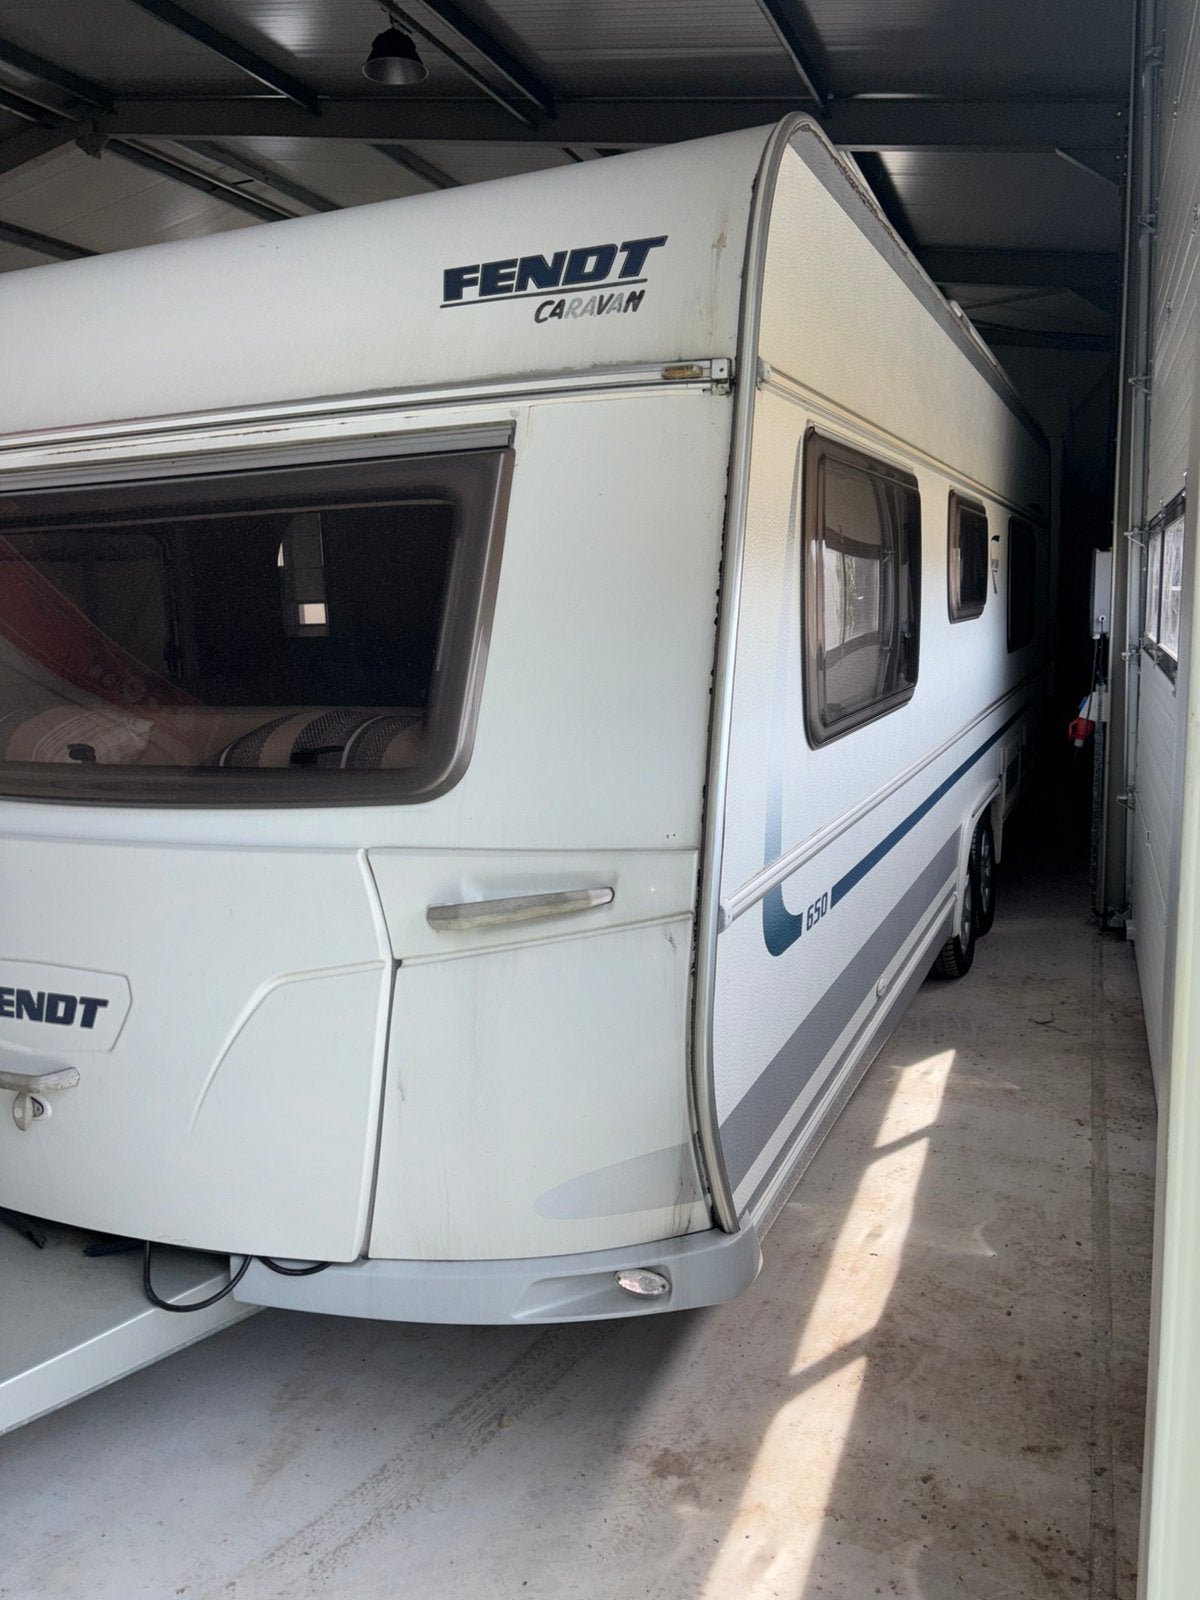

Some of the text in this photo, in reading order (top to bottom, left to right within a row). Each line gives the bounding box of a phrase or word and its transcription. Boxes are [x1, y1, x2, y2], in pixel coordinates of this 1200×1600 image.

[443, 235, 669, 302] FENDT
[534, 289, 646, 324] CARAVAN
[806, 891, 829, 931] 650
[0, 986, 109, 1029] ENDT
